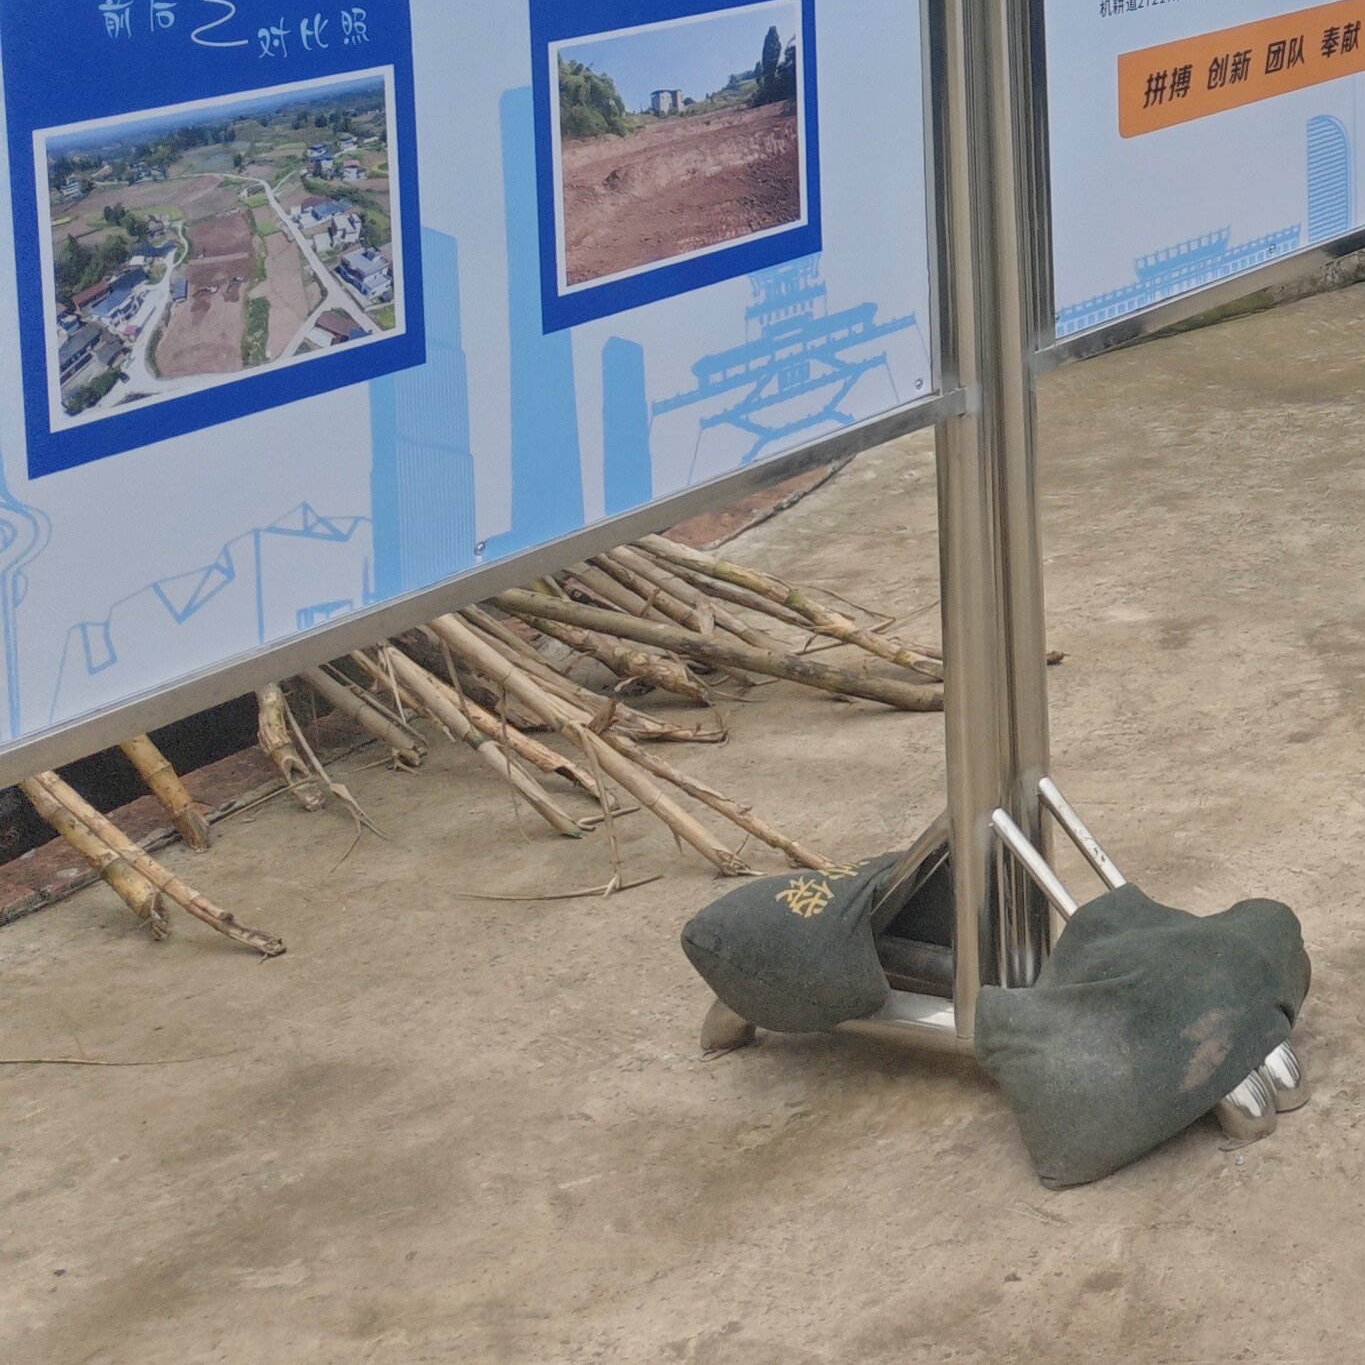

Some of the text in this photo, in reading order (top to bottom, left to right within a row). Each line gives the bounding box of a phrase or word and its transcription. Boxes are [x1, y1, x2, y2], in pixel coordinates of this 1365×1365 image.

[1142, 20, 1362, 110] 拼搏 创新 团队 奉献
